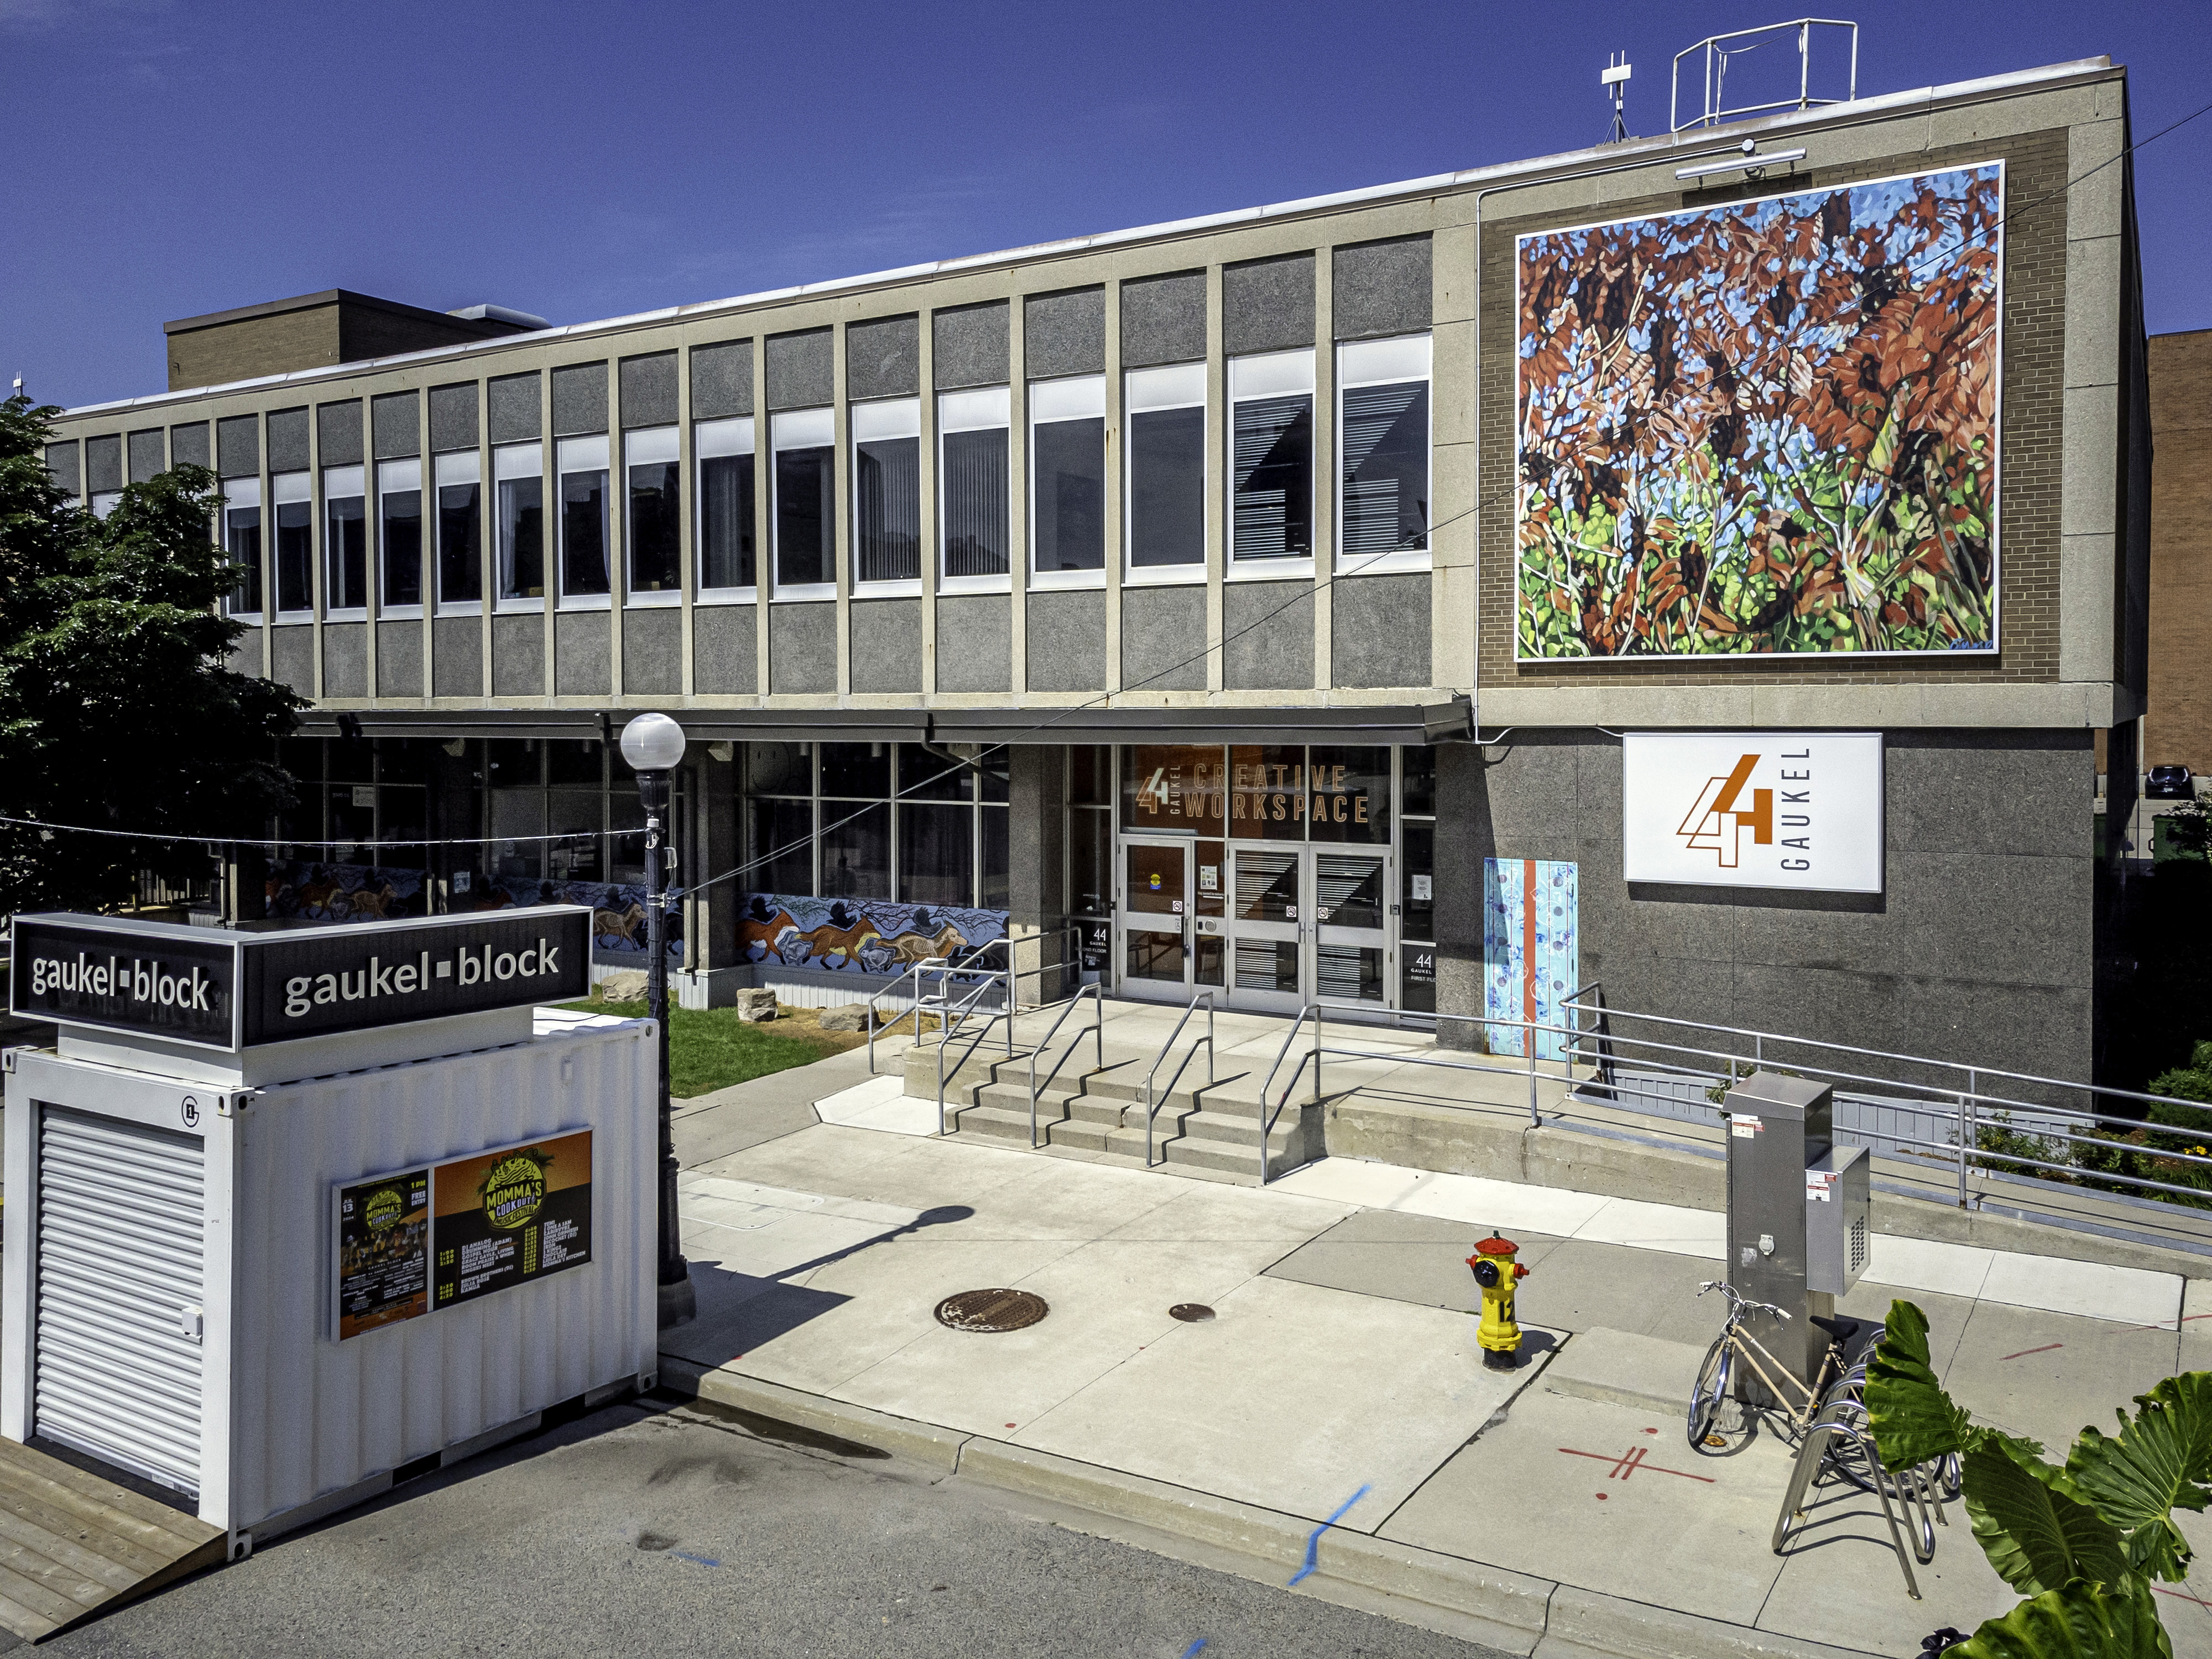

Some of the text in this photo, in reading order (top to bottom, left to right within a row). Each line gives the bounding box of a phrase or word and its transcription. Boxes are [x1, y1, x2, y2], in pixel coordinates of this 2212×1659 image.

[1193, 764, 1345, 792] CREATIVE
[1170, 766, 1180, 814] GAUKEL
[1185, 792, 1368, 823] WORKSPACE
[1676, 748, 1810, 871] 44 GAUKEL
[1094, 928, 1106, 941] 44
[1416, 953, 1431, 968] 44
[411, 1190, 426, 1200] FREE
[411, 1197, 426, 1206] ENTRY
[487, 1182, 541, 1210] MOMMA'S
[342, 1204, 353, 1213] 13
[367, 1203, 401, 1221] MOMMA'S
[494, 1206, 534, 1224] MUSIC FESTIVAL
[497, 1197, 531, 1217] COOKOUT
[462, 1243, 491, 1255] DRUMMING
[492, 1237, 512, 1248] (ADAM)
[469, 1238, 492, 1249] ANALOG
[462, 1251, 482, 1260] GOSPEL
[483, 1246, 498, 1255] HOUR
[462, 1256, 478, 1265] GRACE
[498, 1246, 514, 1254] LIVING
[478, 1256, 494, 1265] PRAISE
[500, 1250, 514, 1259] WHEN
[566, 1250, 586, 1261] KITCHEN
[461, 1275, 479, 1284] BROWN
[480, 1267, 503, 1279] BROTHERS
[462, 1265, 481, 1275] SINGERS
[461, 1280, 476, 1288] JULIA
[477, 1276, 490, 1284] ROSE
